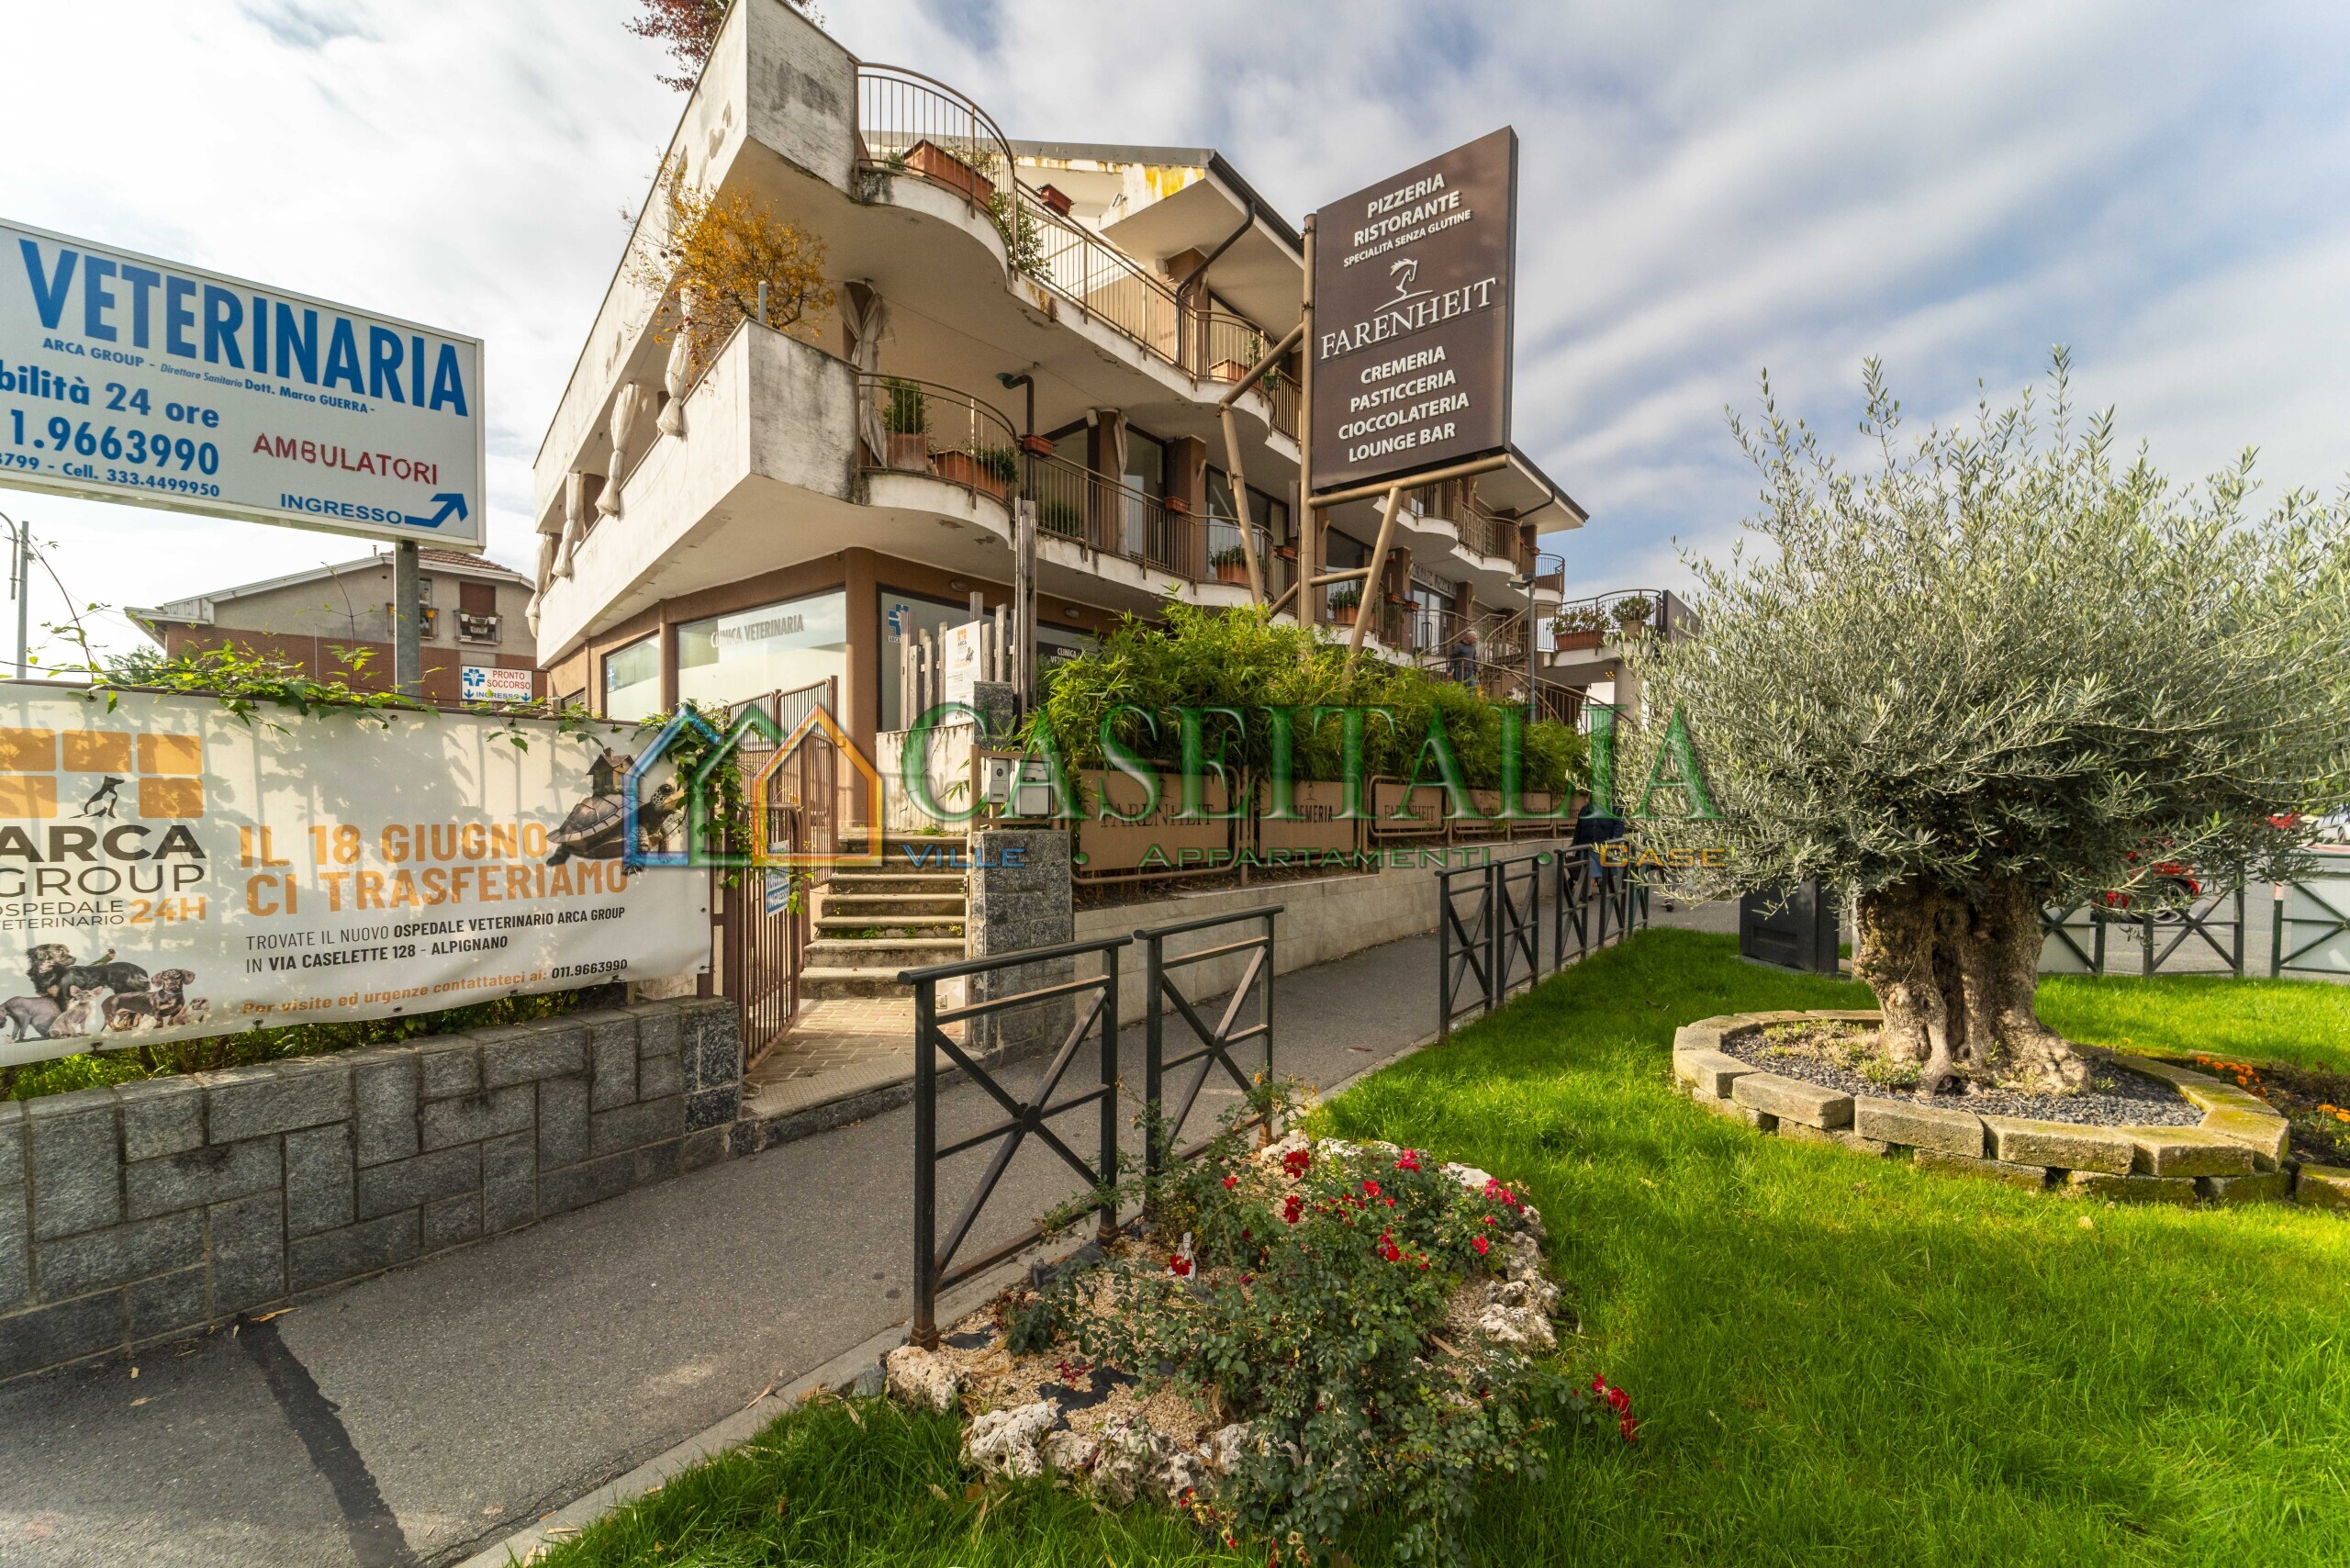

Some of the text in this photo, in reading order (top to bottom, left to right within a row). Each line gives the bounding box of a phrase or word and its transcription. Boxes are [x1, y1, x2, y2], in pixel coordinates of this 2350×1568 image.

[1367, 173, 1445, 218] PIZZERIA
[1343, 208, 1472, 267] SPECIALITÀ SENZA GLUTINE
[1353, 191, 1460, 247] RISTORANTE
[19, 238, 469, 418] VETERINARIA
[1320, 277, 1496, 360] FARENHEIT
[42, 338, 85, 356] ARCA
[90, 347, 144, 367] GROUP
[161, 364, 201, 380] Direttore
[203, 372, 242, 388] Sanitario
[244, 378, 276, 396] Dott.
[279, 386, 316, 402] Marco
[319, 395, 368, 414] GUERRA
[1360, 345, 1446, 384] CREMERIA
[105, 382, 151, 416] 24
[165, 401, 219, 428] ore
[1350, 369, 1456, 413] PASTICCERIA
[1337, 392, 1470, 440] CIOCCOLATERIA
[10, 409, 219, 476] 1.9663990
[252, 432, 438, 486] AMBULATORI
[1348, 422, 1456, 463] LOUNGE BAR
[62, 462, 98, 480] Cell.
[106, 468, 220, 497] 333.4499950
[280, 493, 402, 525] INGRESSO
[744, 614, 804, 641] VETERINARIA
[492, 670, 525, 679] PRONTO
[1057, 647, 1077, 659] CLINICA
[487, 679, 531, 690] SOCCORSO
[1286, 804, 1333, 823] CREMERIA
[0, 824, 207, 862] ARCA
[241, 823, 548, 868] IL 18 GIUGNO
[0, 864, 205, 898] GROUP
[246, 860, 629, 918] CI TRASFERIAMO
[0, 896, 207, 924] SPEDALE 24H
[0, 915, 124, 931] ETERINARIO
[246, 906, 626, 951] TROVATE IL NUOVO OSPEDALE VETERINARIO ARCA GROUP
[246, 958, 263, 974] IN
[268, 953, 297, 971] VIA
[301, 946, 388, 969] CASELETTE
[392, 943, 416, 960] 128
[431, 935, 509, 957] ALPIGNANO
[242, 1002, 277, 1015] Per
[282, 995, 332, 1014] visite
[337, 991, 359, 1007] ed
[364, 985, 429, 1006] urgenze
[433, 970, 526, 993] contattateci
[551, 958, 628, 980] 011.9663990
